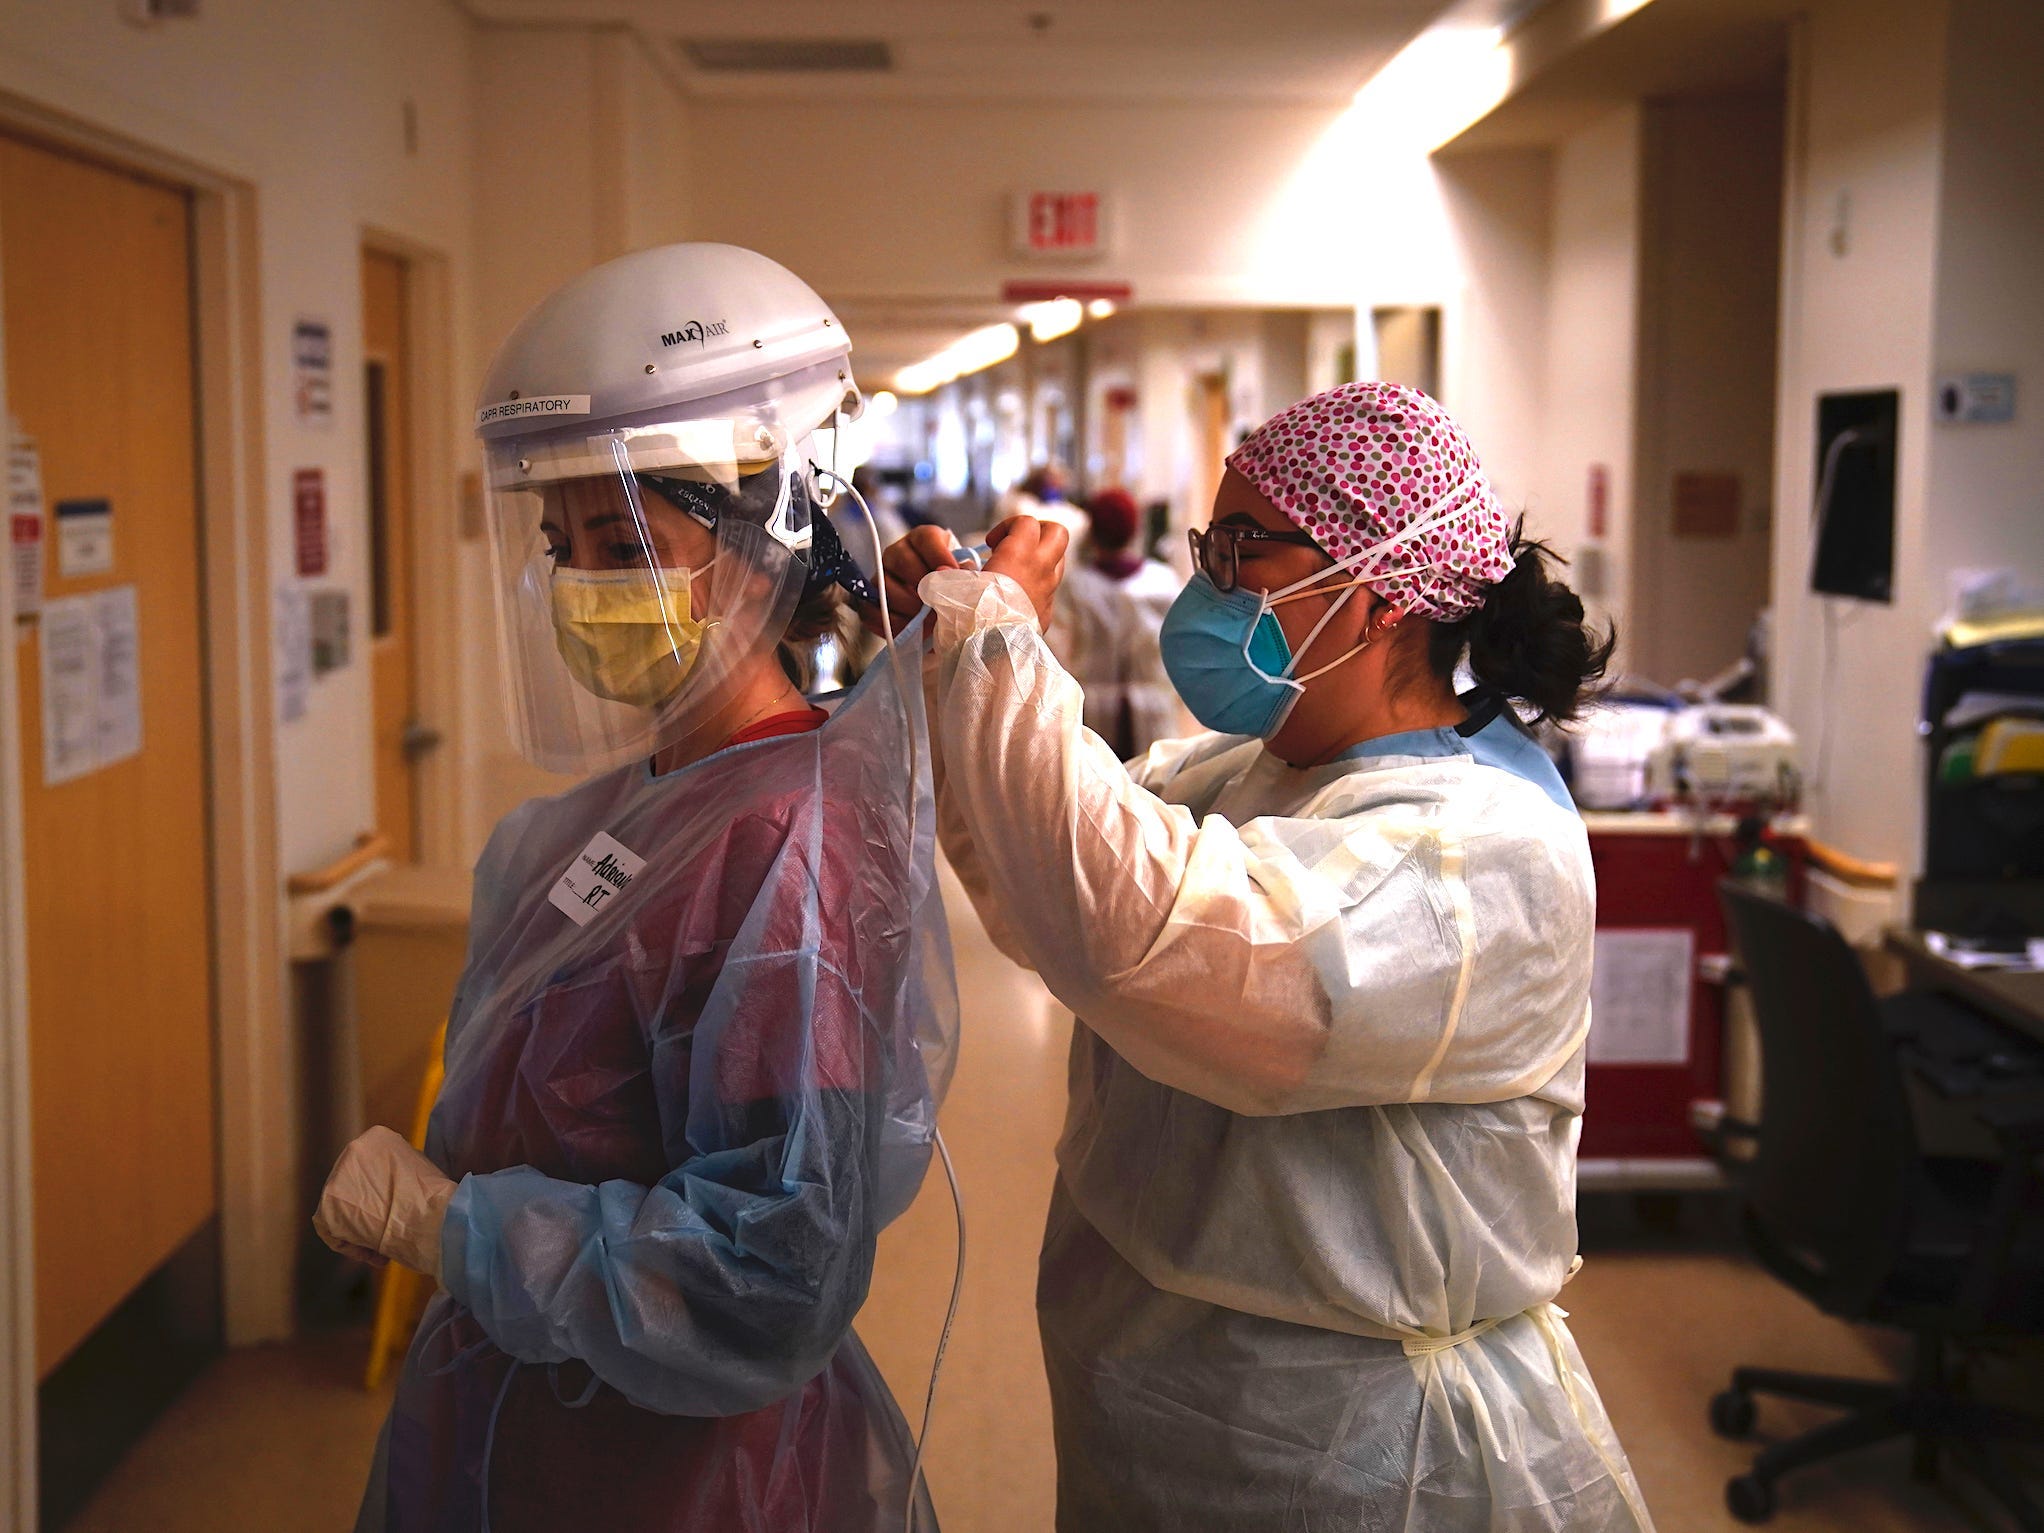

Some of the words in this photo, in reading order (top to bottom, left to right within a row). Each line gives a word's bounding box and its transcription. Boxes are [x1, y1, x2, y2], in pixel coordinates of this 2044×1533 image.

[1030, 193, 1097, 246] EXIT
[661, 327, 698, 347] MAX
[480, 408, 497, 421] CAPR
[499, 400, 571, 416] RESPIRATORY
[583, 885, 611, 909] RT
